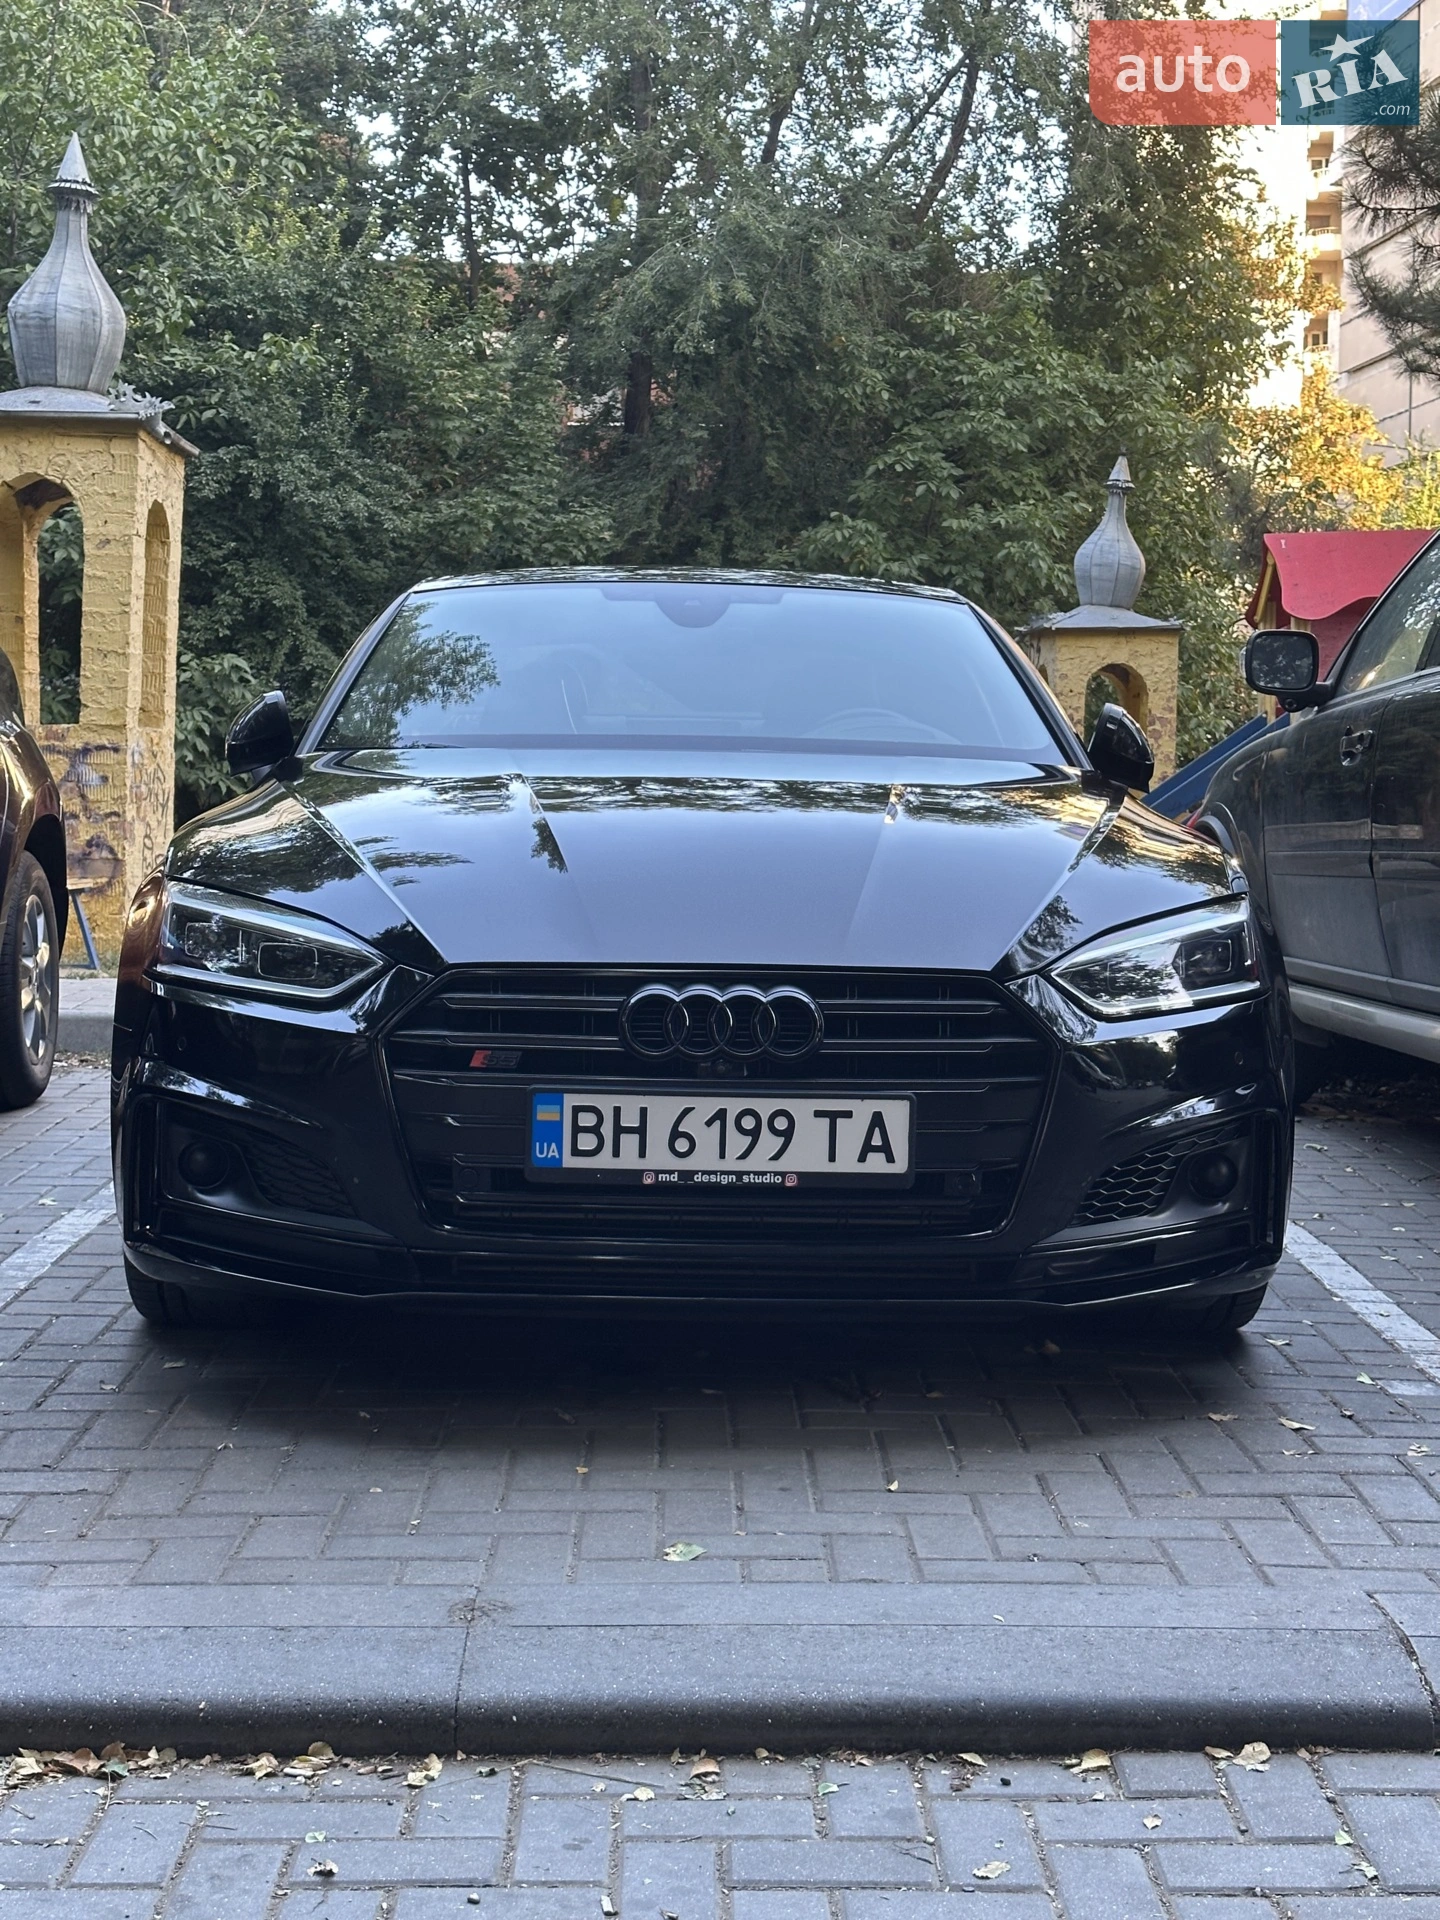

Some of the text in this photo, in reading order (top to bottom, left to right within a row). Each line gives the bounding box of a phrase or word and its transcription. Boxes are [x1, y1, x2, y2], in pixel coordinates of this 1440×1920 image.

[535, 1141, 560, 1159] UA
[570, 1104, 896, 1164] BH 6199 TA
